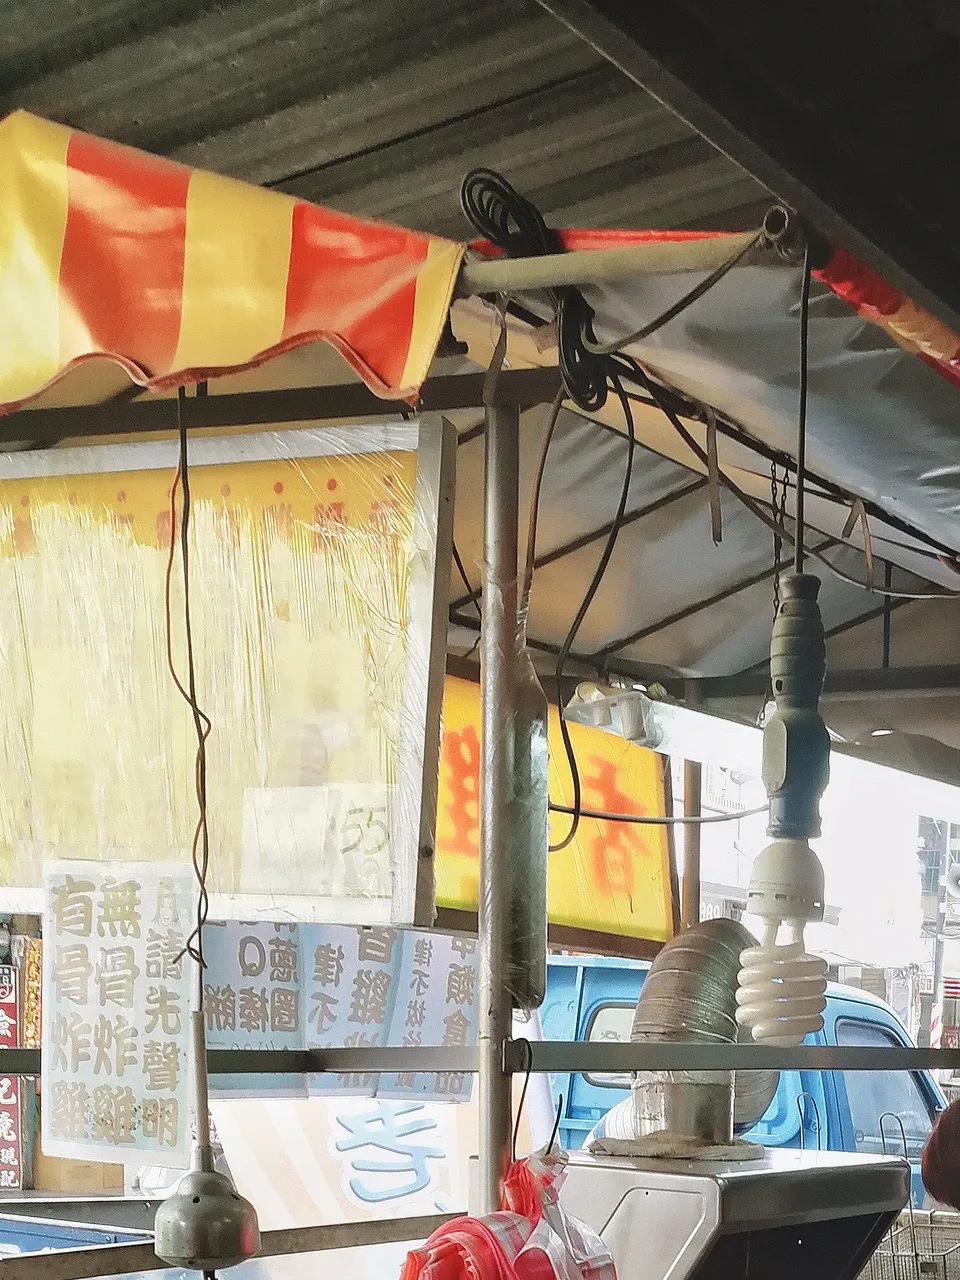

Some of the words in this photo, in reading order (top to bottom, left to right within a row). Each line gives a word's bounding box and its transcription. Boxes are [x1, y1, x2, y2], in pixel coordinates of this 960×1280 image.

[50, 874, 96, 1140] 有骨炸雞
[91, 875, 141, 1146] 無骨炸雞
[142, 928, 184, 1148] 請先聲明
